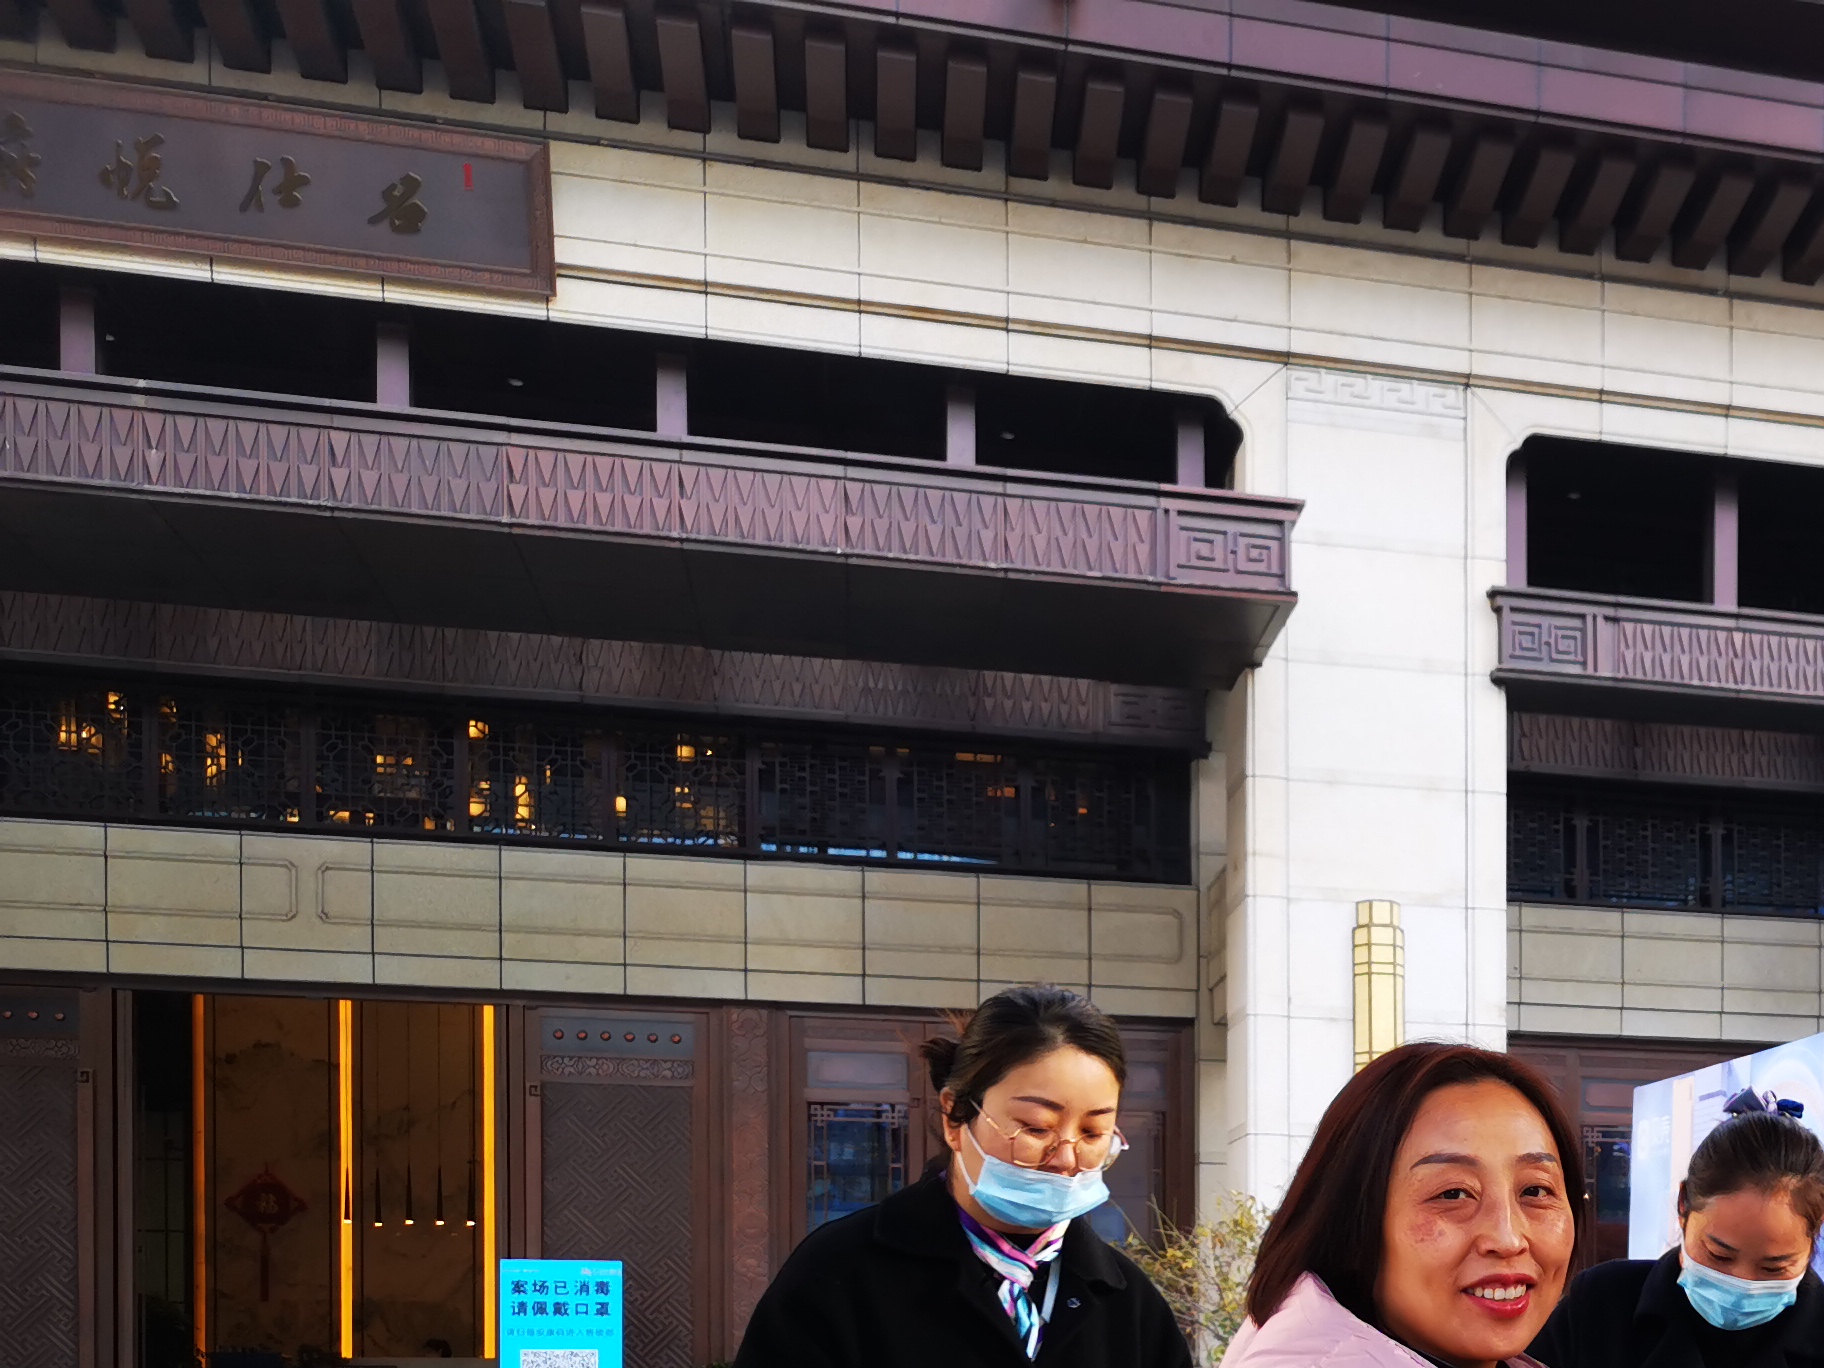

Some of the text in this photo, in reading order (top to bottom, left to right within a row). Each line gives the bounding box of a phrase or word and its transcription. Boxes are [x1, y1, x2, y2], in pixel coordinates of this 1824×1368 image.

[511, 1280, 611, 1296] 案场已消毒
[511, 1301, 611, 1317] 请佩戴口罩
